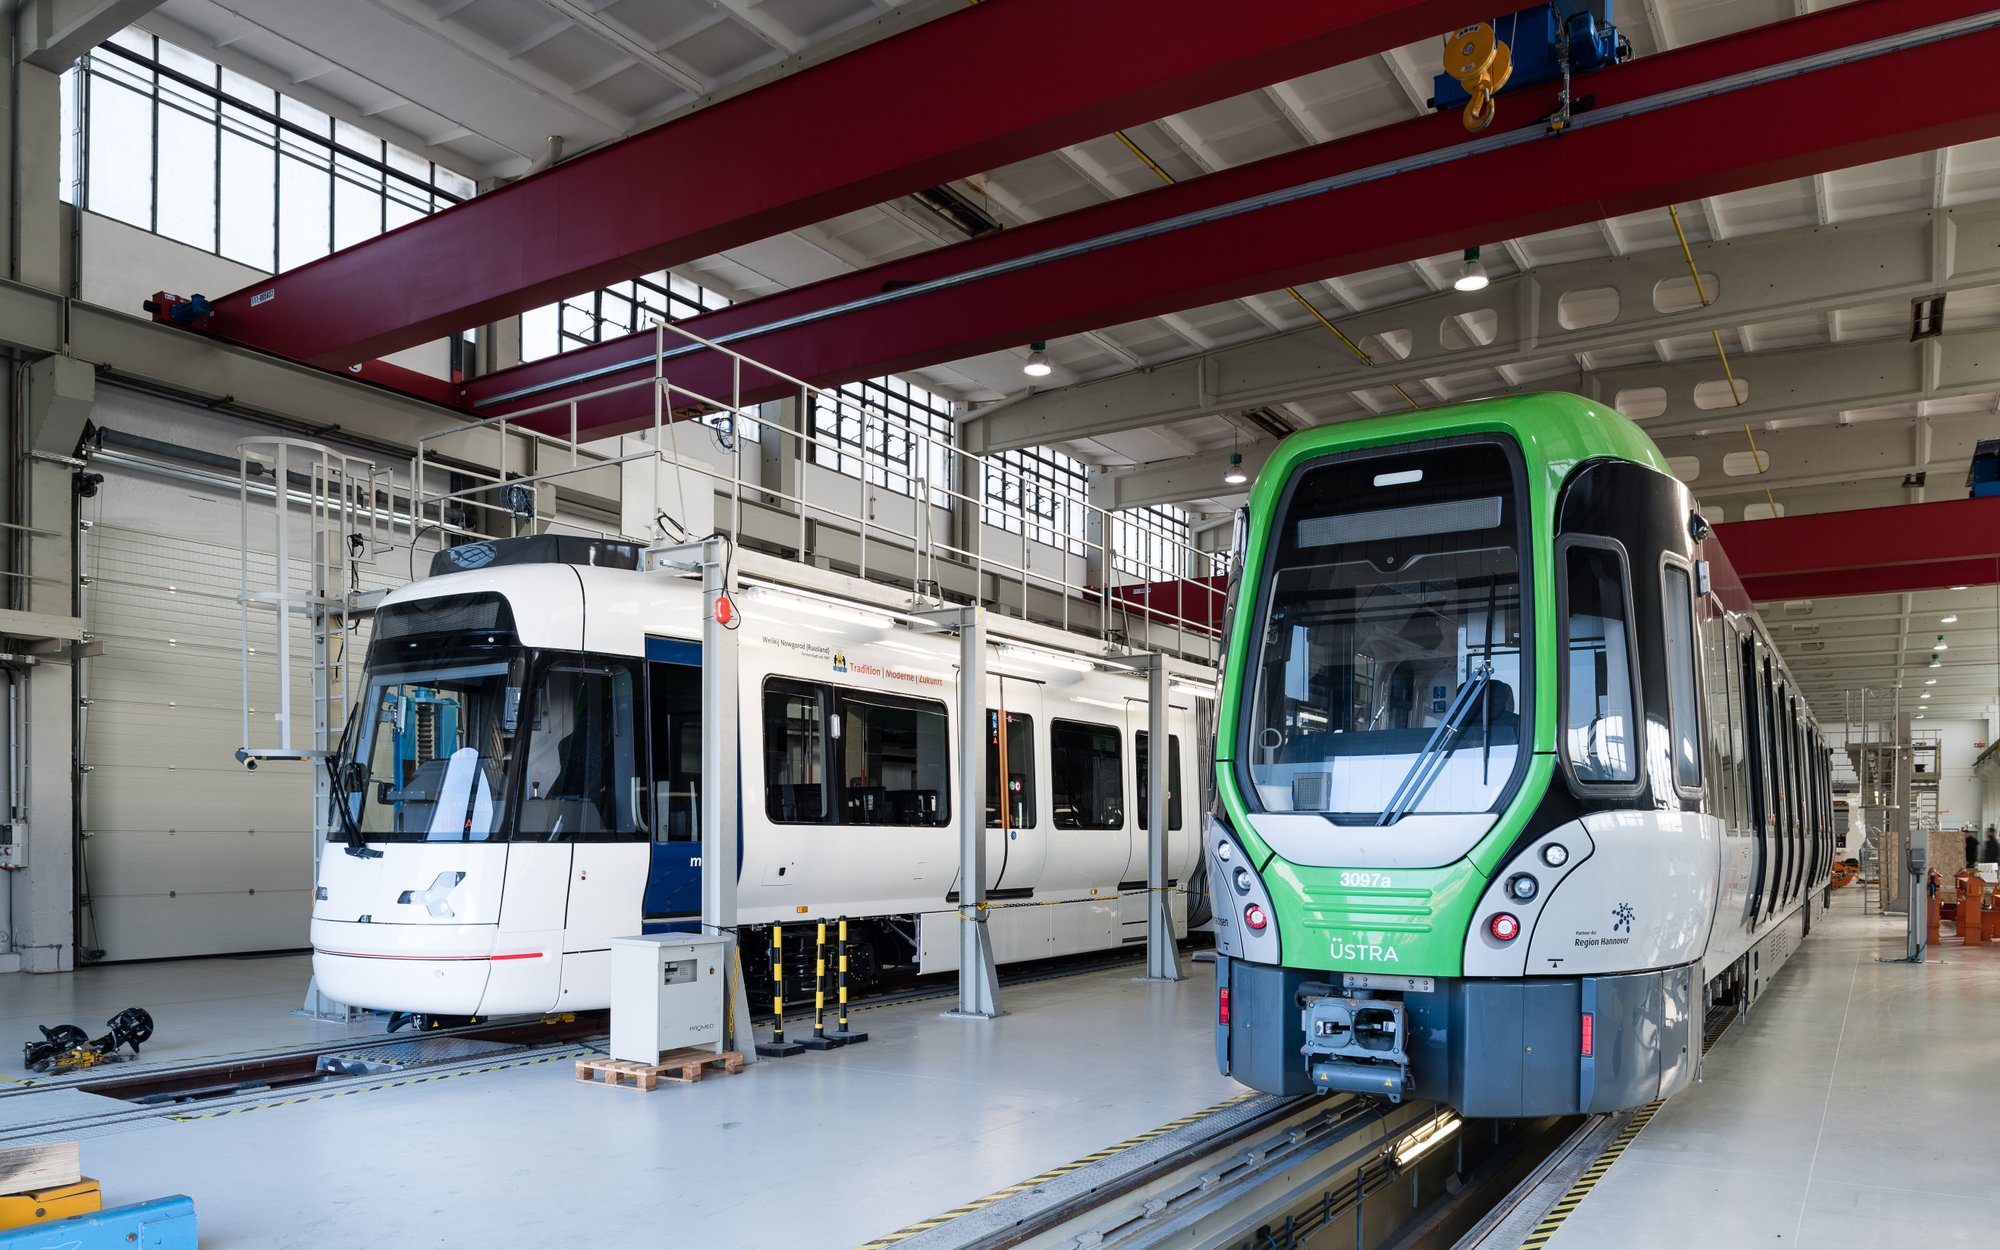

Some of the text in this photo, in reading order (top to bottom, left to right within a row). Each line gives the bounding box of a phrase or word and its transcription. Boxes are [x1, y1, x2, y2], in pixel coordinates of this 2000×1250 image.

[780, 639, 805, 650] Nowgorod
[806, 643, 830, 655] (Russland)
[850, 662, 881, 676] Tradition
[885, 669, 915, 682] Moderne
[1340, 872, 1391, 888] 3097a
[1330, 937, 1400, 962] ÜSTRA
[1575, 937, 1629, 948] Region Hannover
